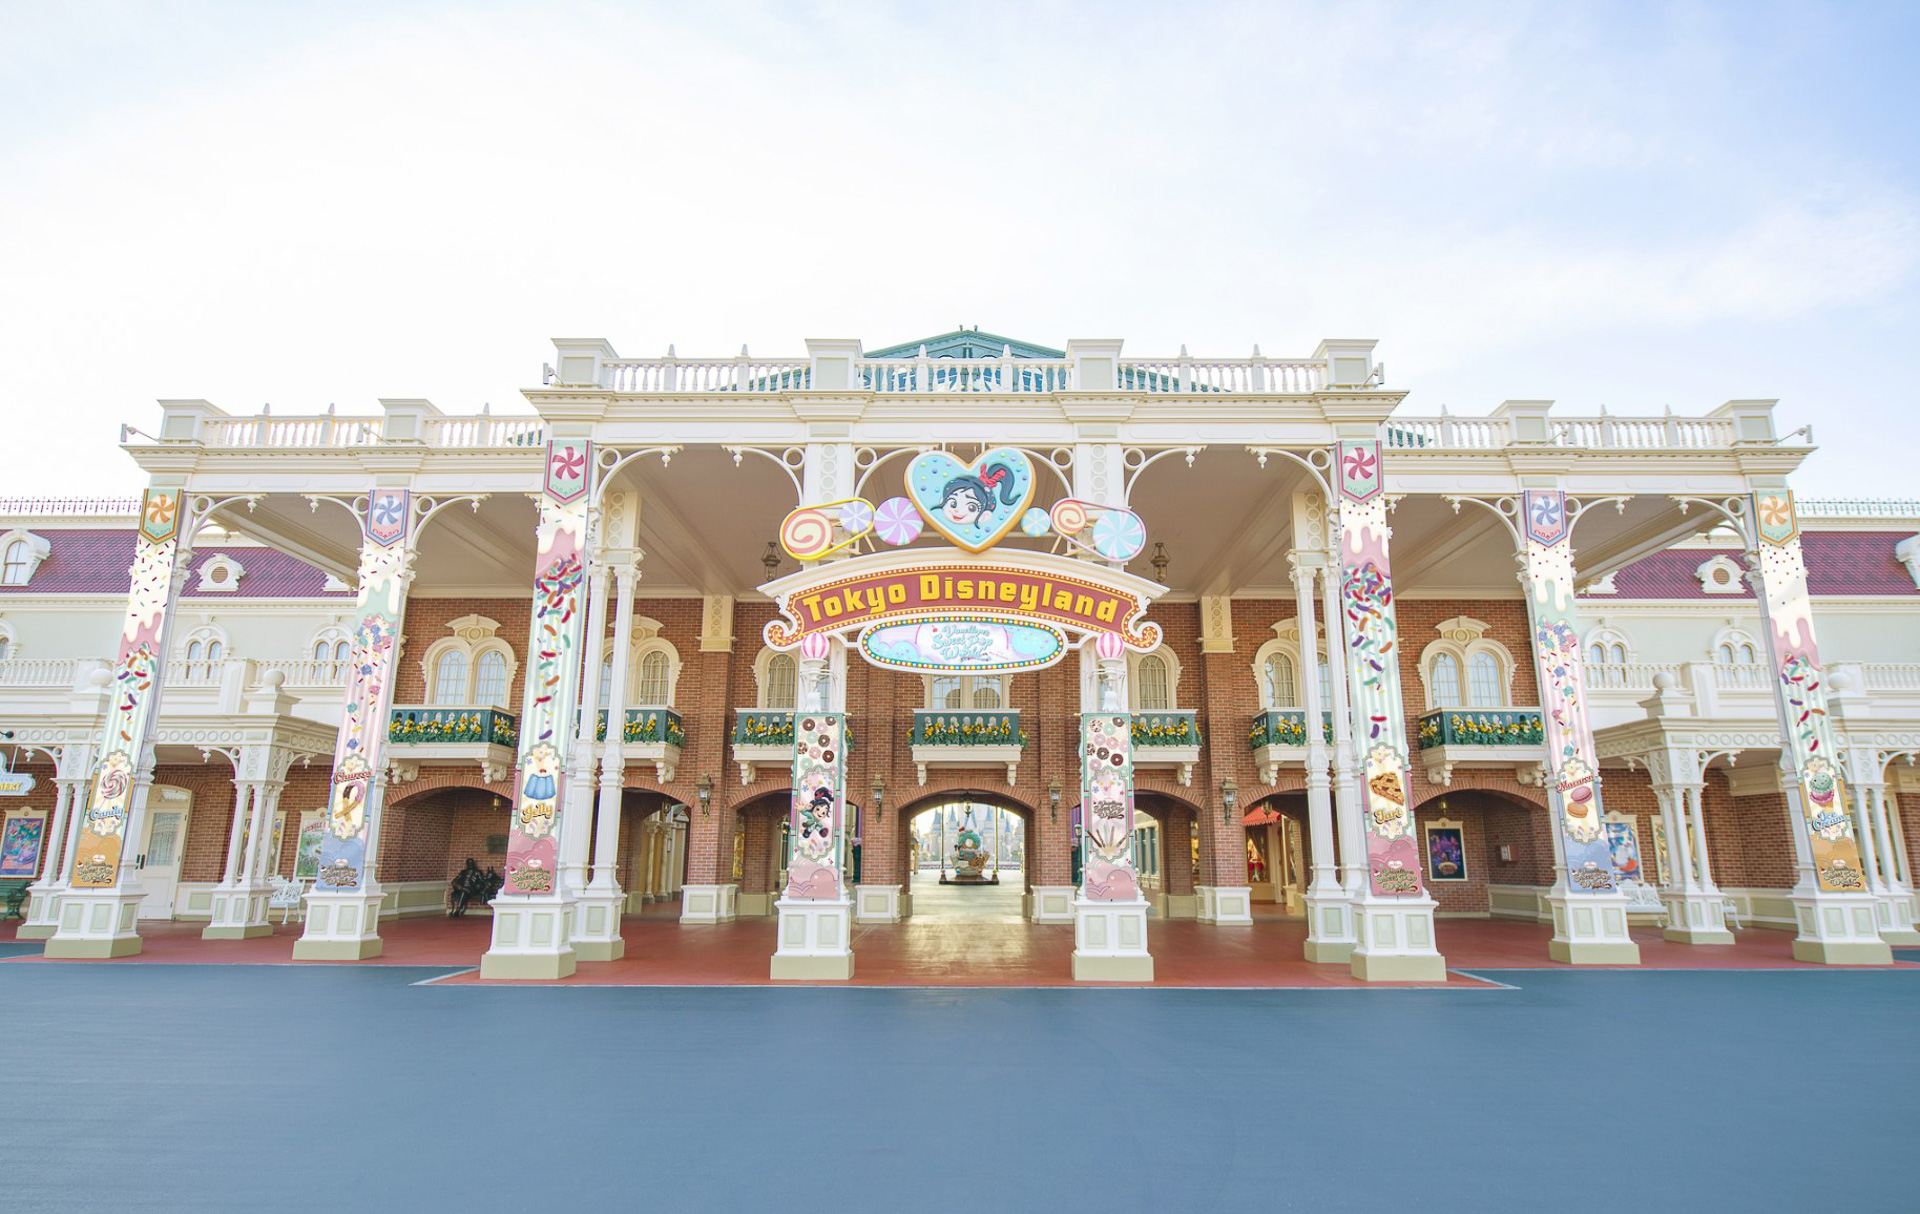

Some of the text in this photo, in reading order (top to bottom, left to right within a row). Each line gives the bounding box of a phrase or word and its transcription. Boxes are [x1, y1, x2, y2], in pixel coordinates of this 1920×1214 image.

[802, 574, 1119, 624] Tokyo Disneyland
[931, 633, 966, 650] Sweet
[521, 803, 553, 823] Jelly
[1374, 807, 1402, 824] Tart
